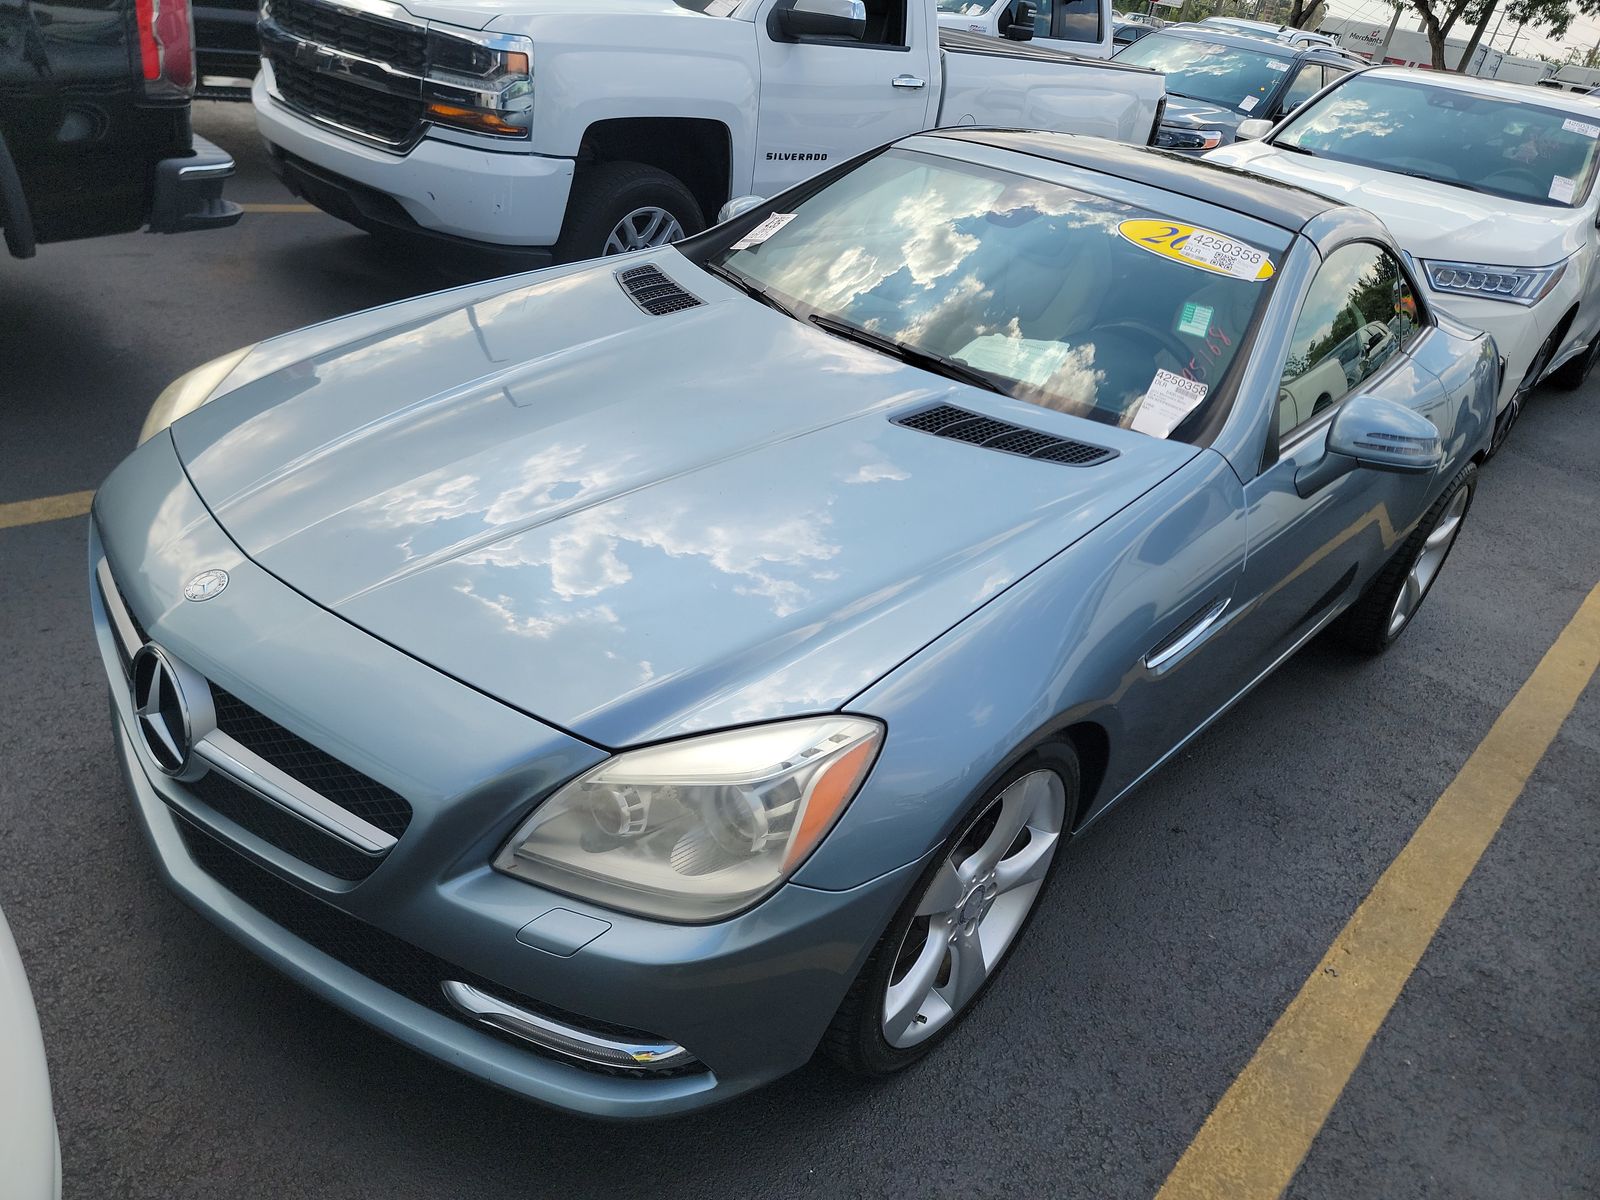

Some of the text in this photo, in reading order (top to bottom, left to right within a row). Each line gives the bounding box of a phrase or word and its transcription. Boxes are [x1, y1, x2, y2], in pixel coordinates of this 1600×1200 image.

[1349, 32, 1384, 44] Merchants
[766, 152, 828, 161] SILVERADO
[1184, 245, 1202, 255] DLR
[1193, 234, 1261, 264] 4250358
[1157, 370, 1207, 396] 4250358
